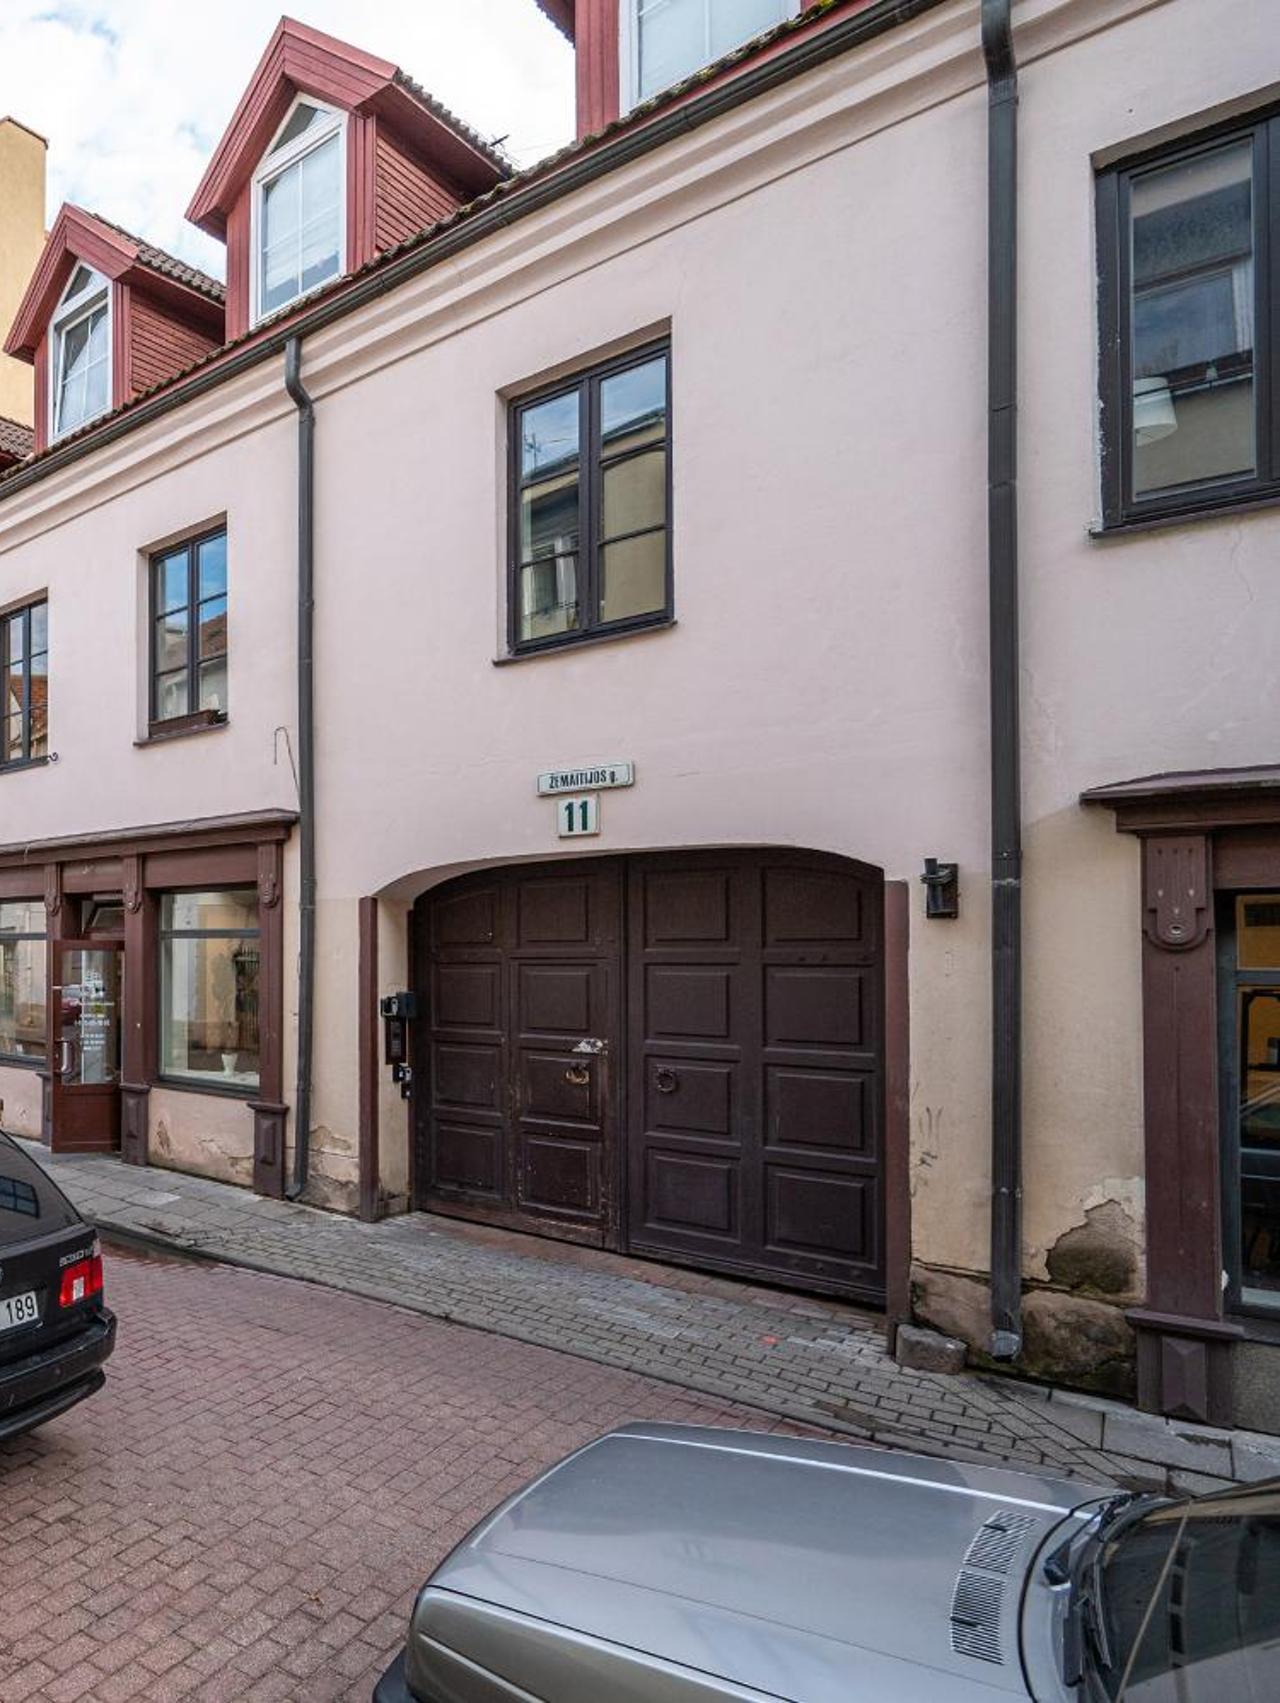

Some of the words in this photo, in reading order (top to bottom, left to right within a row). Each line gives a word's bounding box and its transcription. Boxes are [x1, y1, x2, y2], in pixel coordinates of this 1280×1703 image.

[548, 769, 607, 789] ŽEMAITIJOS
[564, 800, 589, 832] 11
[6, 1295, 35, 1324] 189
